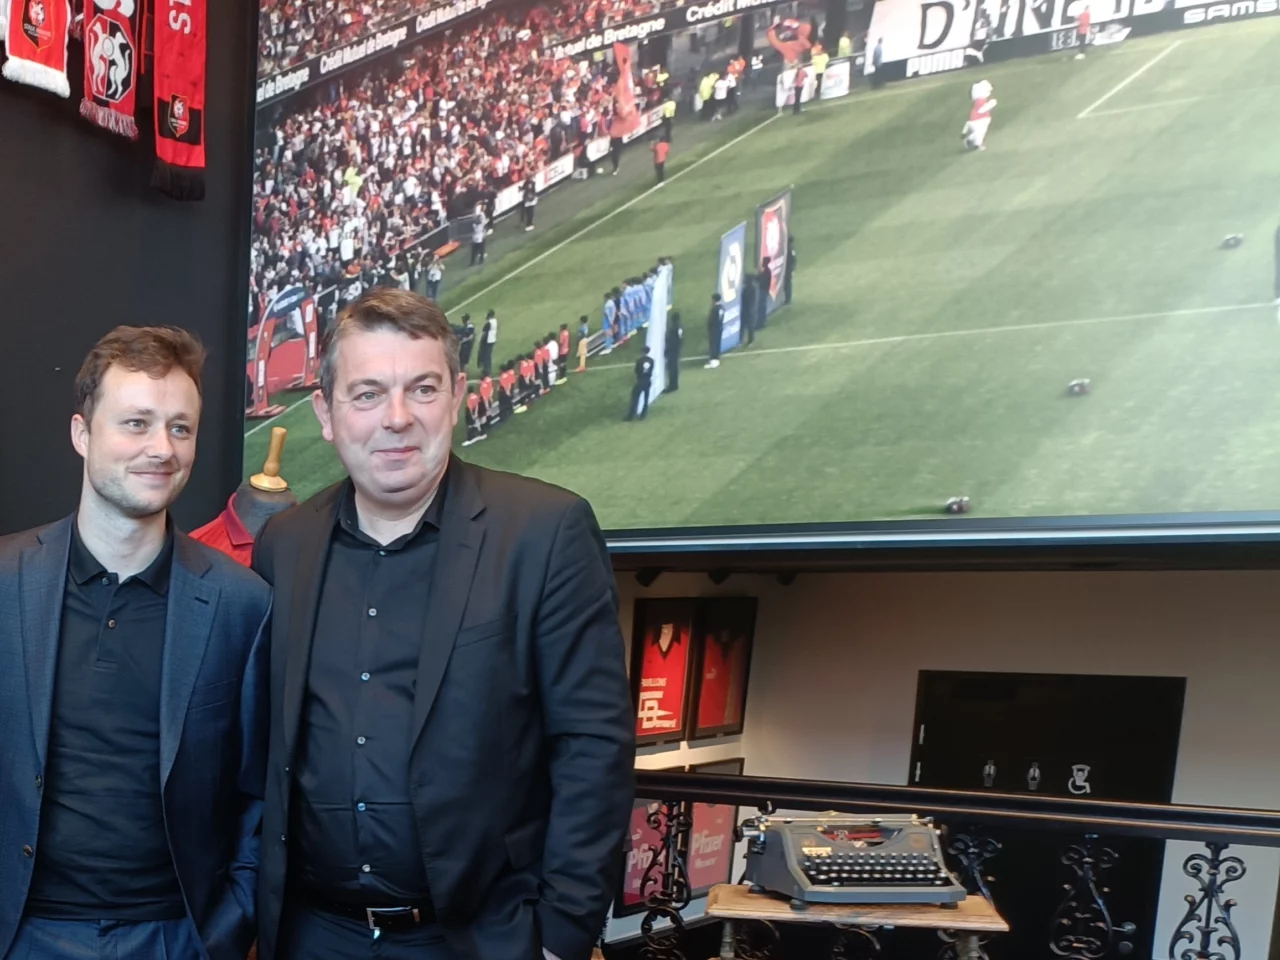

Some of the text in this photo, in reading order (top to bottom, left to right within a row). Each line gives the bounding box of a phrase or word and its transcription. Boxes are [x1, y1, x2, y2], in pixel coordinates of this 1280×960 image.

[685, 0, 735, 23] Crédit
[1182, 0, 1280, 25] SAMS
[586, 33, 603, 50] de
[603, 18, 666, 46] Bretagne
[905, 48, 967, 78] PUMA
[689, 829, 725, 856] Pfizer
